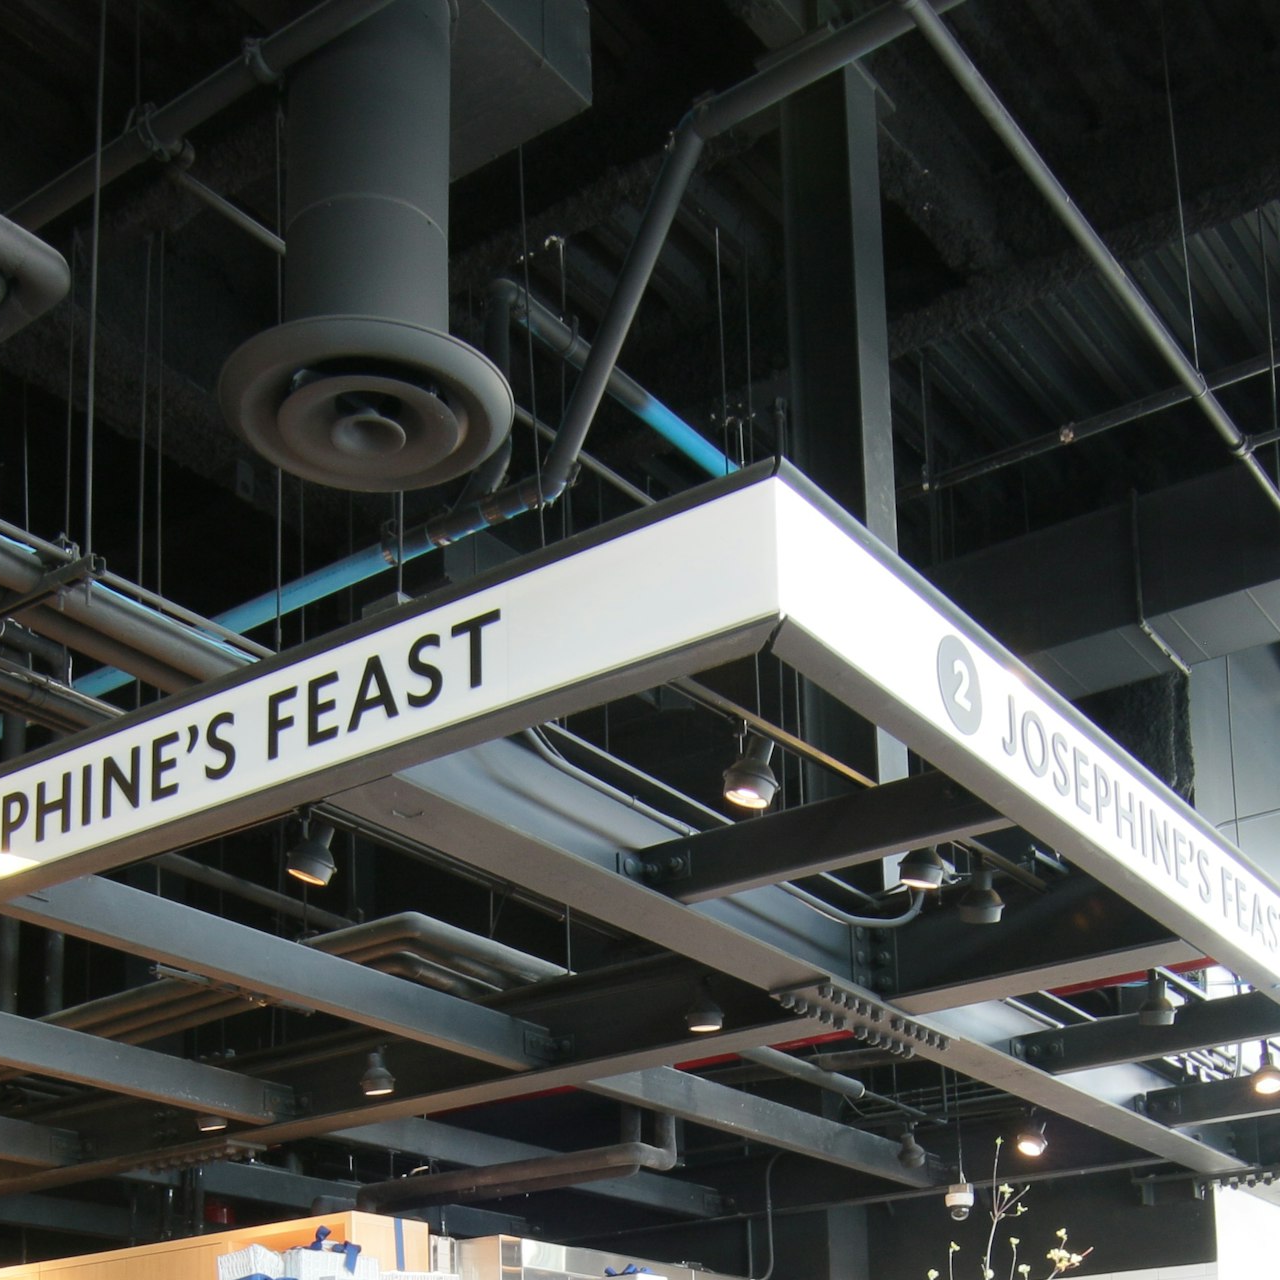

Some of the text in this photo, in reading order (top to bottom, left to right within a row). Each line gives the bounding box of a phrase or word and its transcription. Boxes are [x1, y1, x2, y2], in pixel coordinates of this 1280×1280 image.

[265, 608, 502, 760] FEAST
[952, 657, 973, 712] 2
[1001, 693, 1213, 905] JOSEPHINE'S
